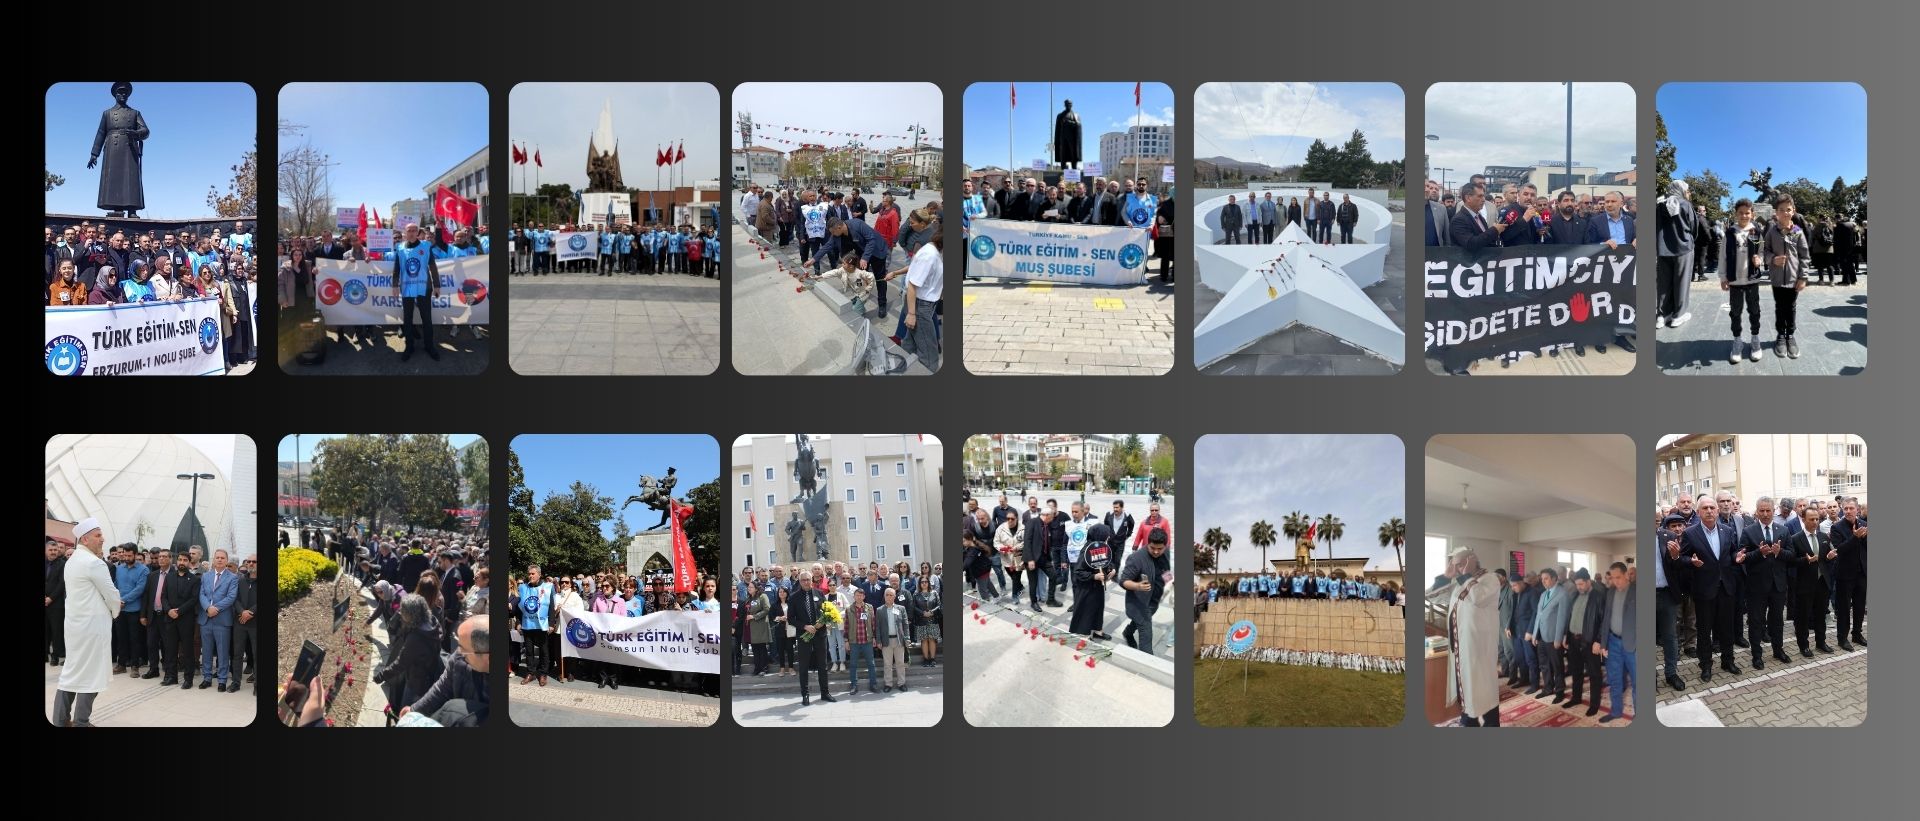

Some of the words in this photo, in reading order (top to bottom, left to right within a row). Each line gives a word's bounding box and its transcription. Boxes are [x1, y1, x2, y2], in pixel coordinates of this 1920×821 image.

[998, 241, 1032, 256] TÜRK
[1036, 243, 1079, 258] EĞİTİM
[1091, 248, 1116, 260] SEN
[1016, 261, 1044, 277] MUŞ
[1048, 263, 1096, 277] ŞUBESİ
[367, 274, 392, 287] TÜRK
[92, 325, 132, 350] TÜRK
[137, 318, 197, 343] EĞİTİM-SEN
[154, 351, 177, 367] NOLU
[178, 347, 197, 361] ŞUBE
[598, 630, 633, 643] TÜRK
[636, 628, 685, 643] EĞİTİM
[600, 642, 645, 653] Samsun
[650, 645, 654, 653] 1
[660, 645, 689, 654] Nolu
